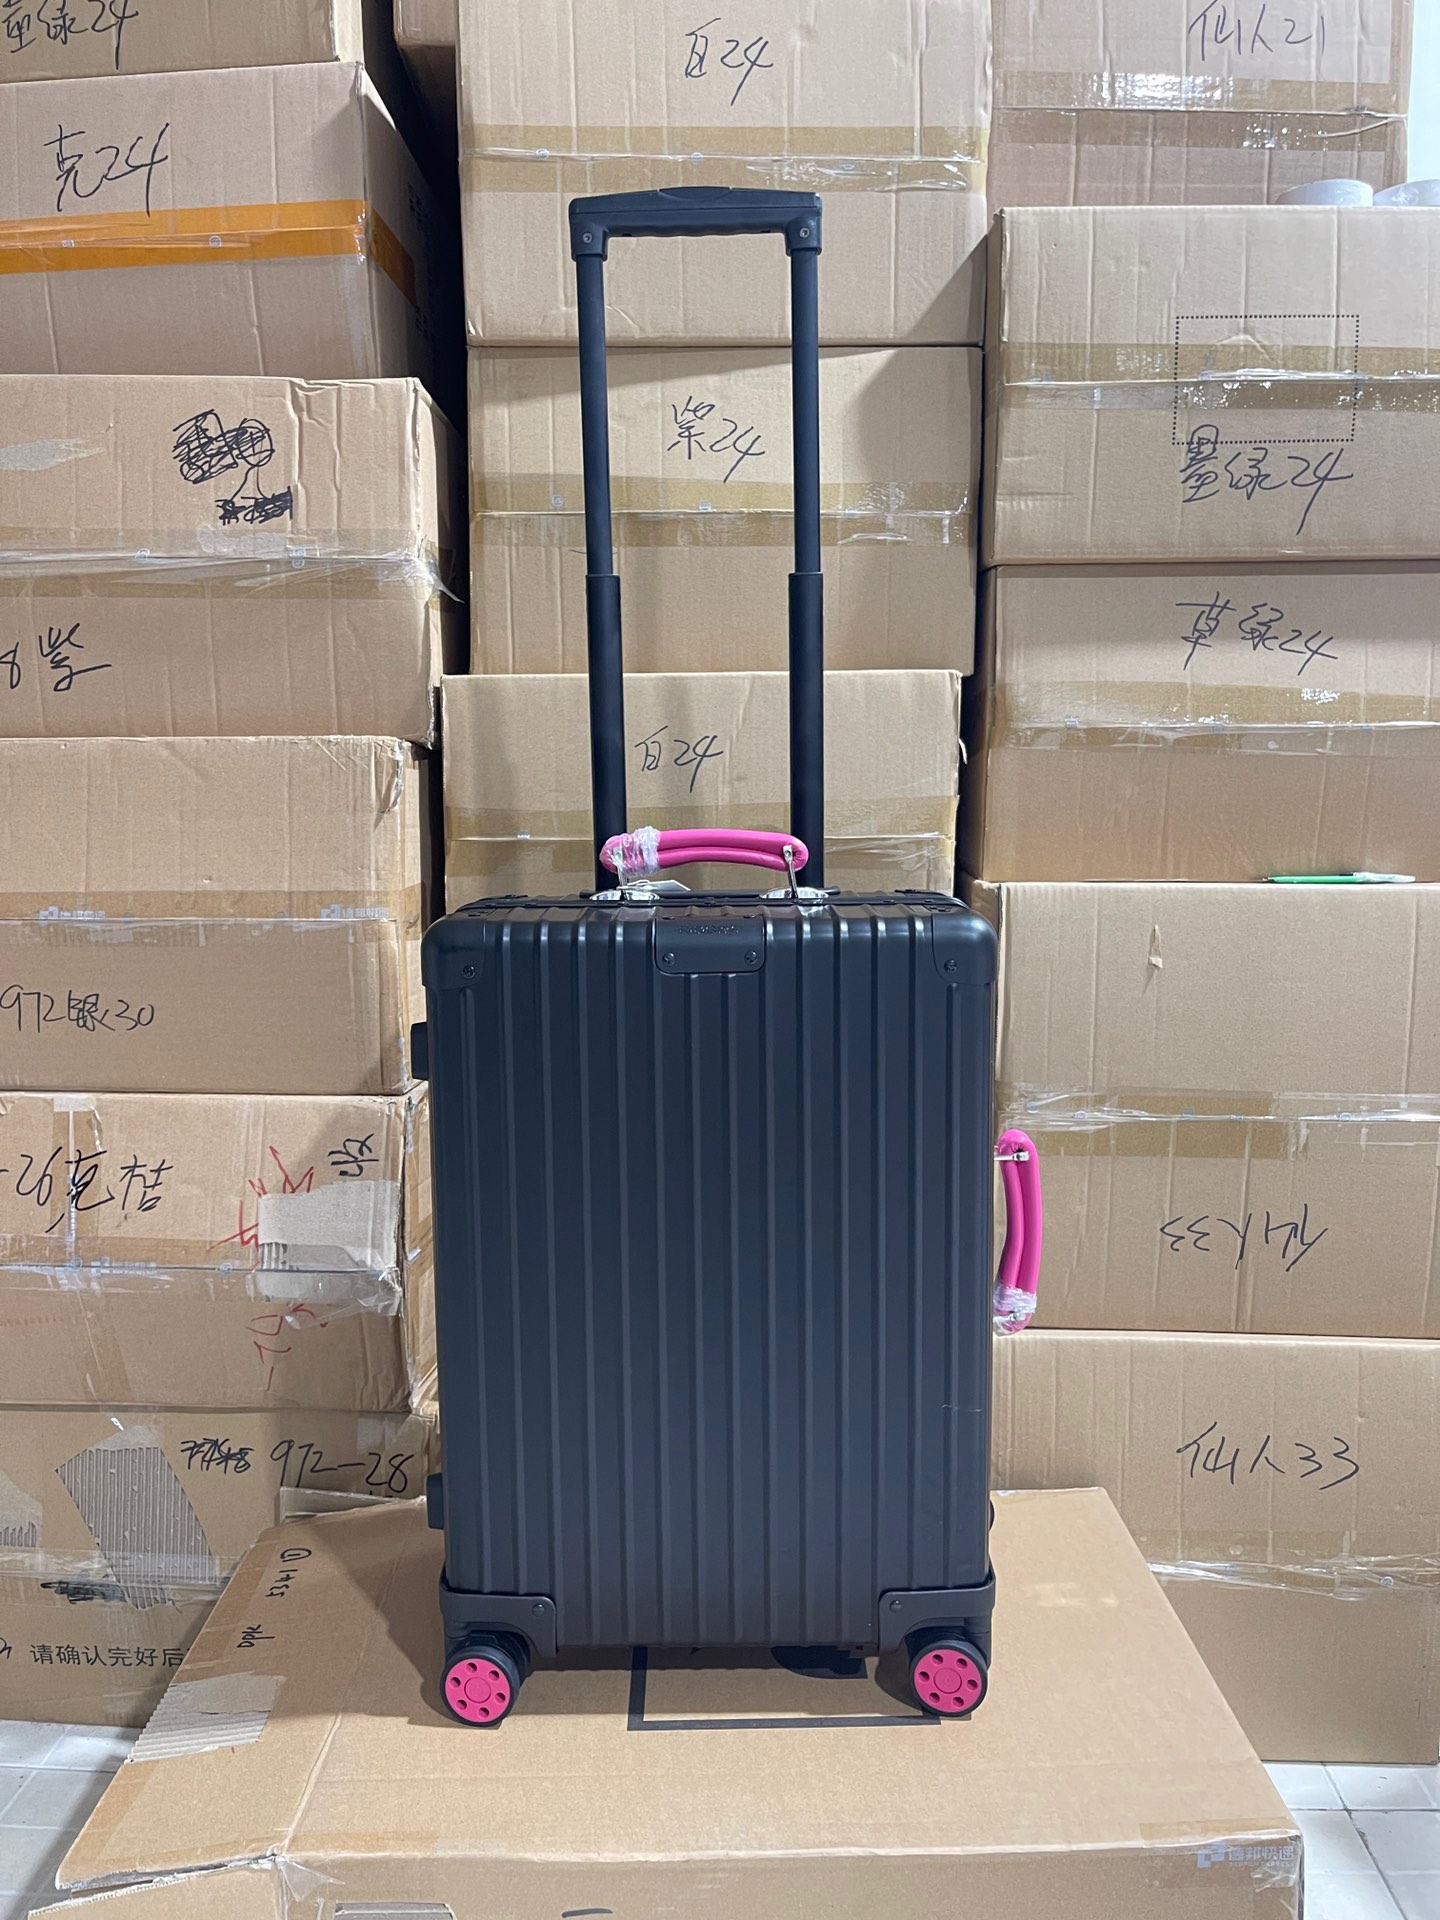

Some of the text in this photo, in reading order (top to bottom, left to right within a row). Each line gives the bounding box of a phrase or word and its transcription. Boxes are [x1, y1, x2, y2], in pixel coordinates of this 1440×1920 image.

[1176, 1421, 1360, 1490] 仙人33
[30, 1643, 190, 1668] 请确认完好后
